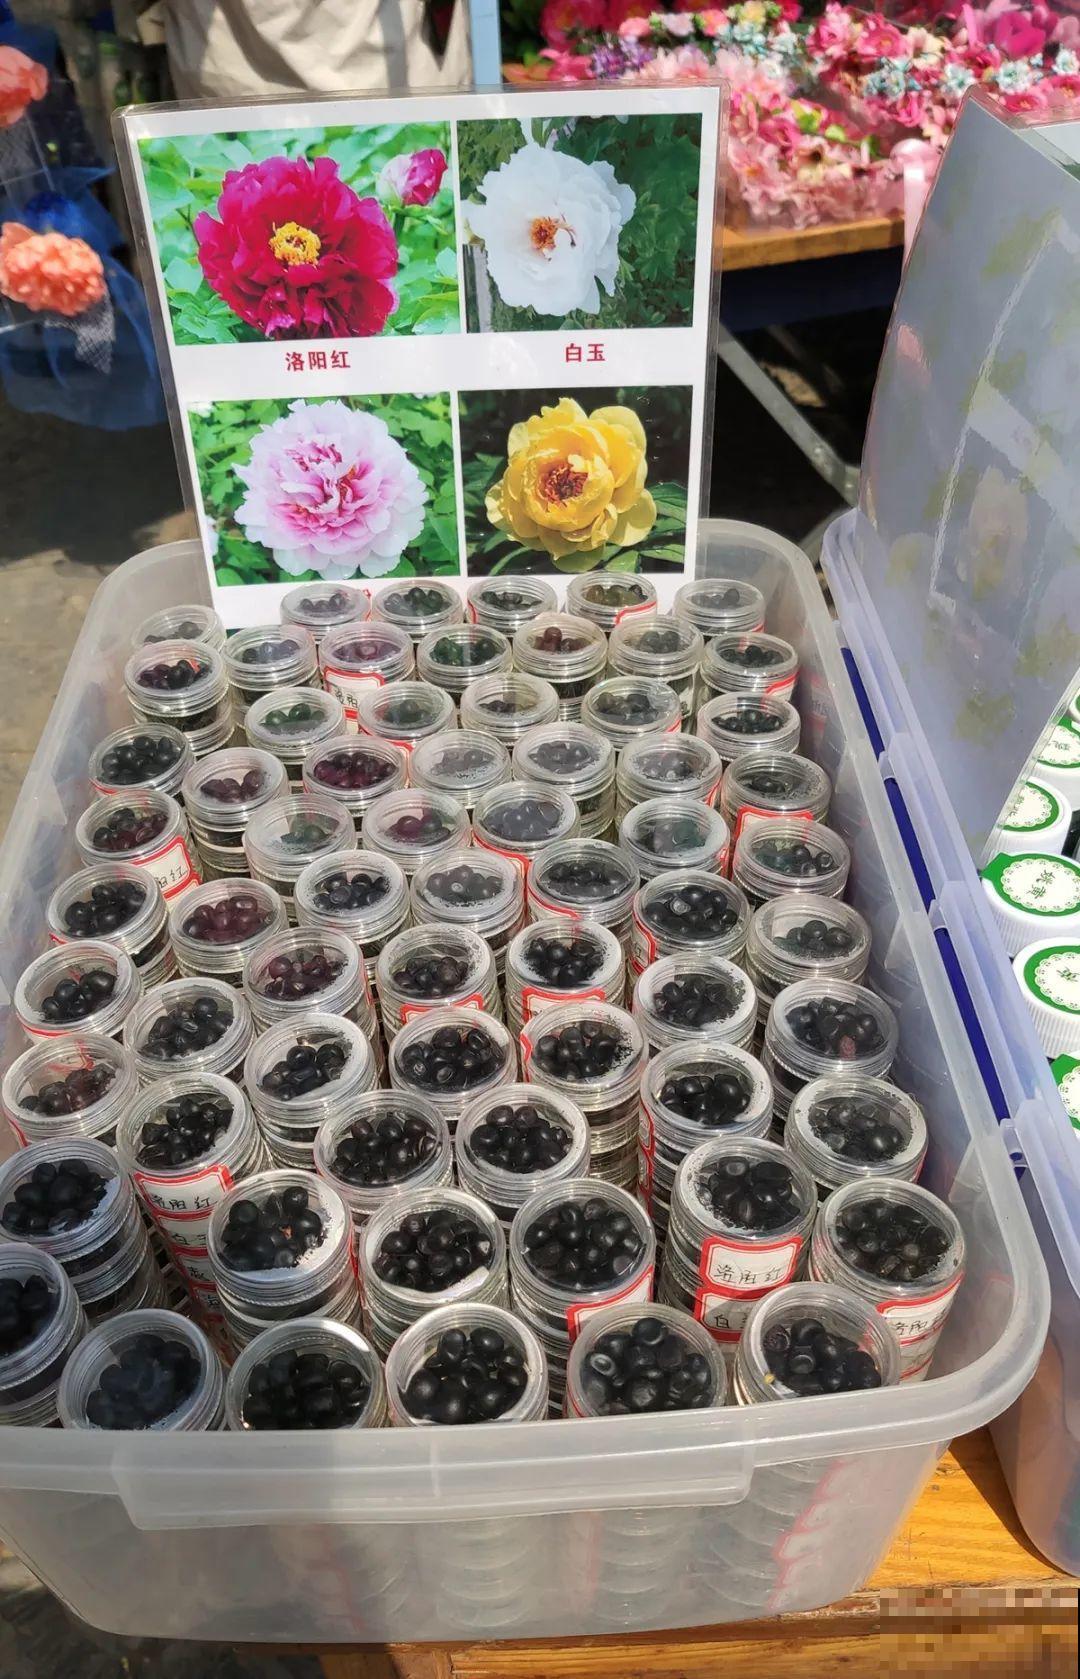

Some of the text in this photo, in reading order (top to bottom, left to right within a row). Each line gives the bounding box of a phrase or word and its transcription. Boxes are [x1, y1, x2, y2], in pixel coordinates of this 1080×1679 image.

[285, 350, 351, 371] 洛阳红
[566, 343, 606, 362] 白玉
[714, 1264, 780, 1284] 洛阳红
